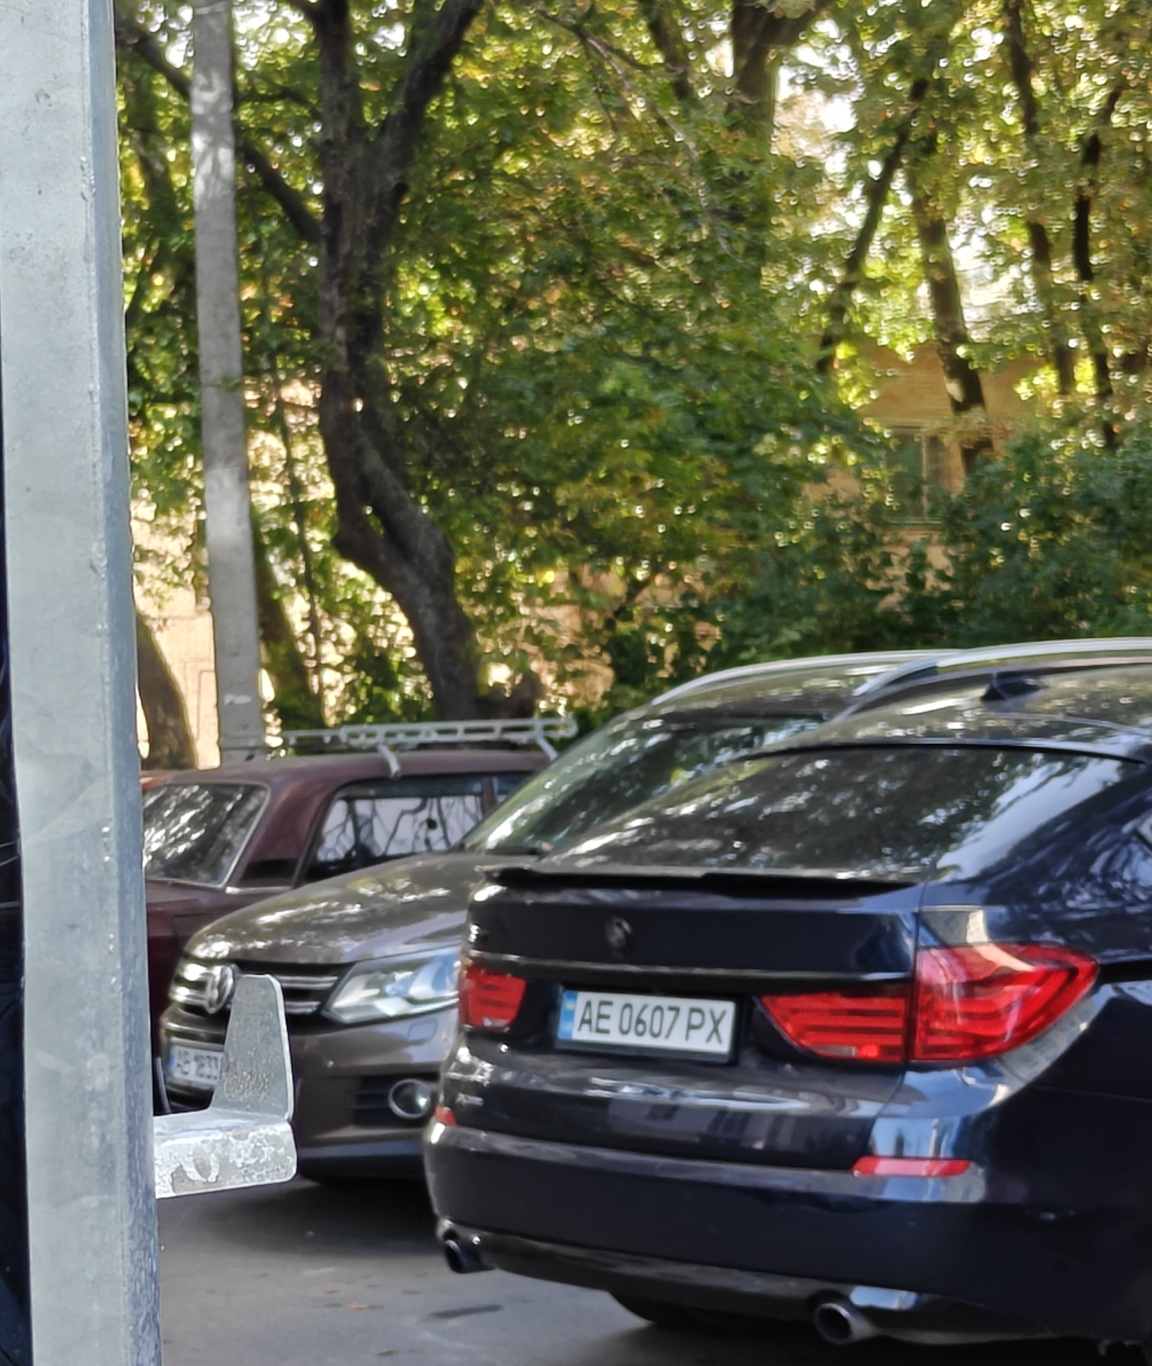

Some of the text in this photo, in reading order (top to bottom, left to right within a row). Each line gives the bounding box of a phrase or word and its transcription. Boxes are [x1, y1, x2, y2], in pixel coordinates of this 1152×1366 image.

[577, 999, 727, 1044] AE 0607 PX
